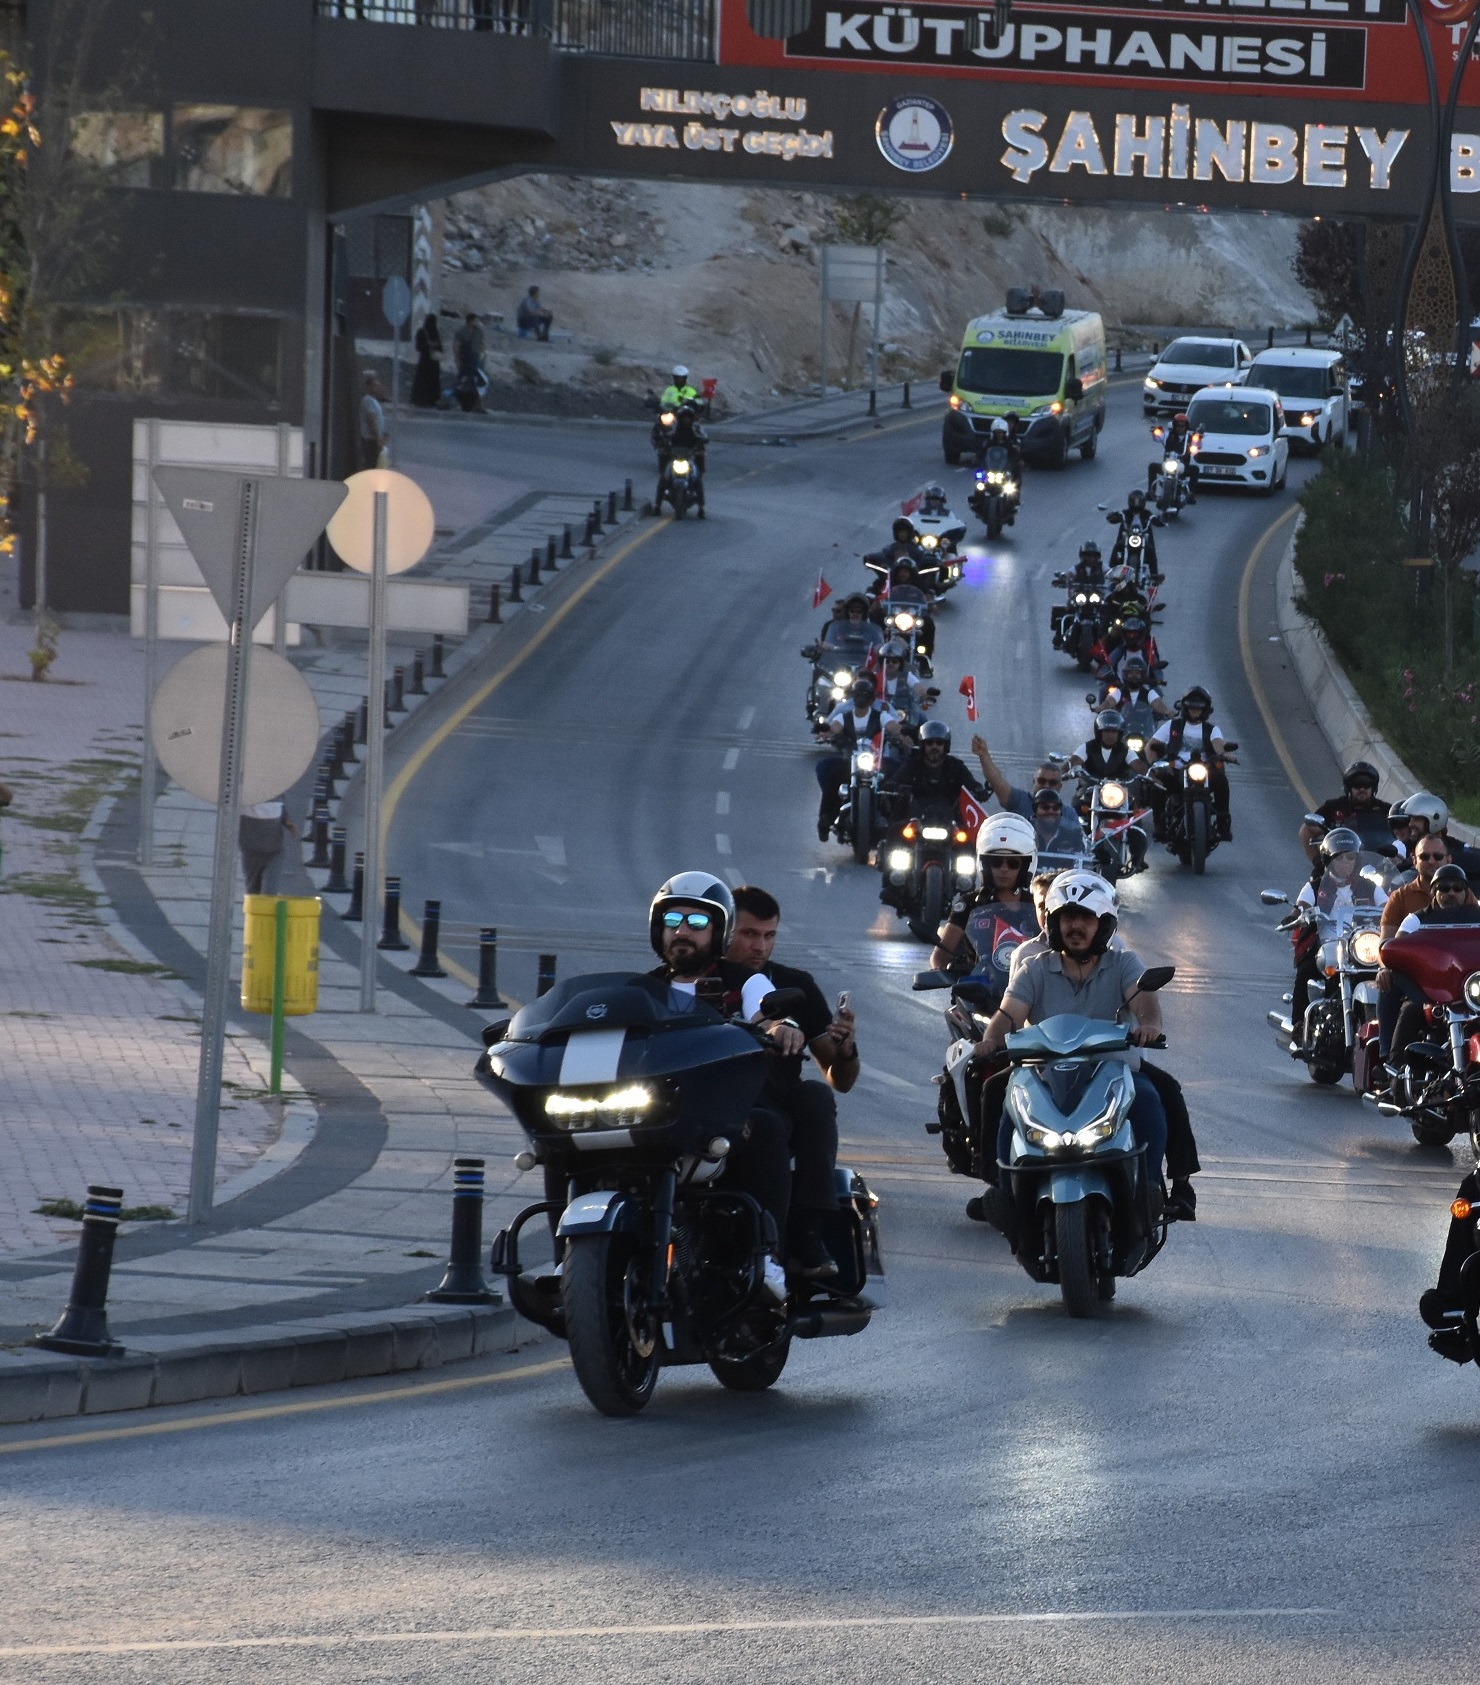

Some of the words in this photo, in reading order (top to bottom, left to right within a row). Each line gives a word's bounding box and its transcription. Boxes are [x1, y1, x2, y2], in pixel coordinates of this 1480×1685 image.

[610, 121, 680, 149] YAYA
[683, 121, 740, 152] ÜST
[1001, 103, 1410, 190] ŞAHİNBEY
